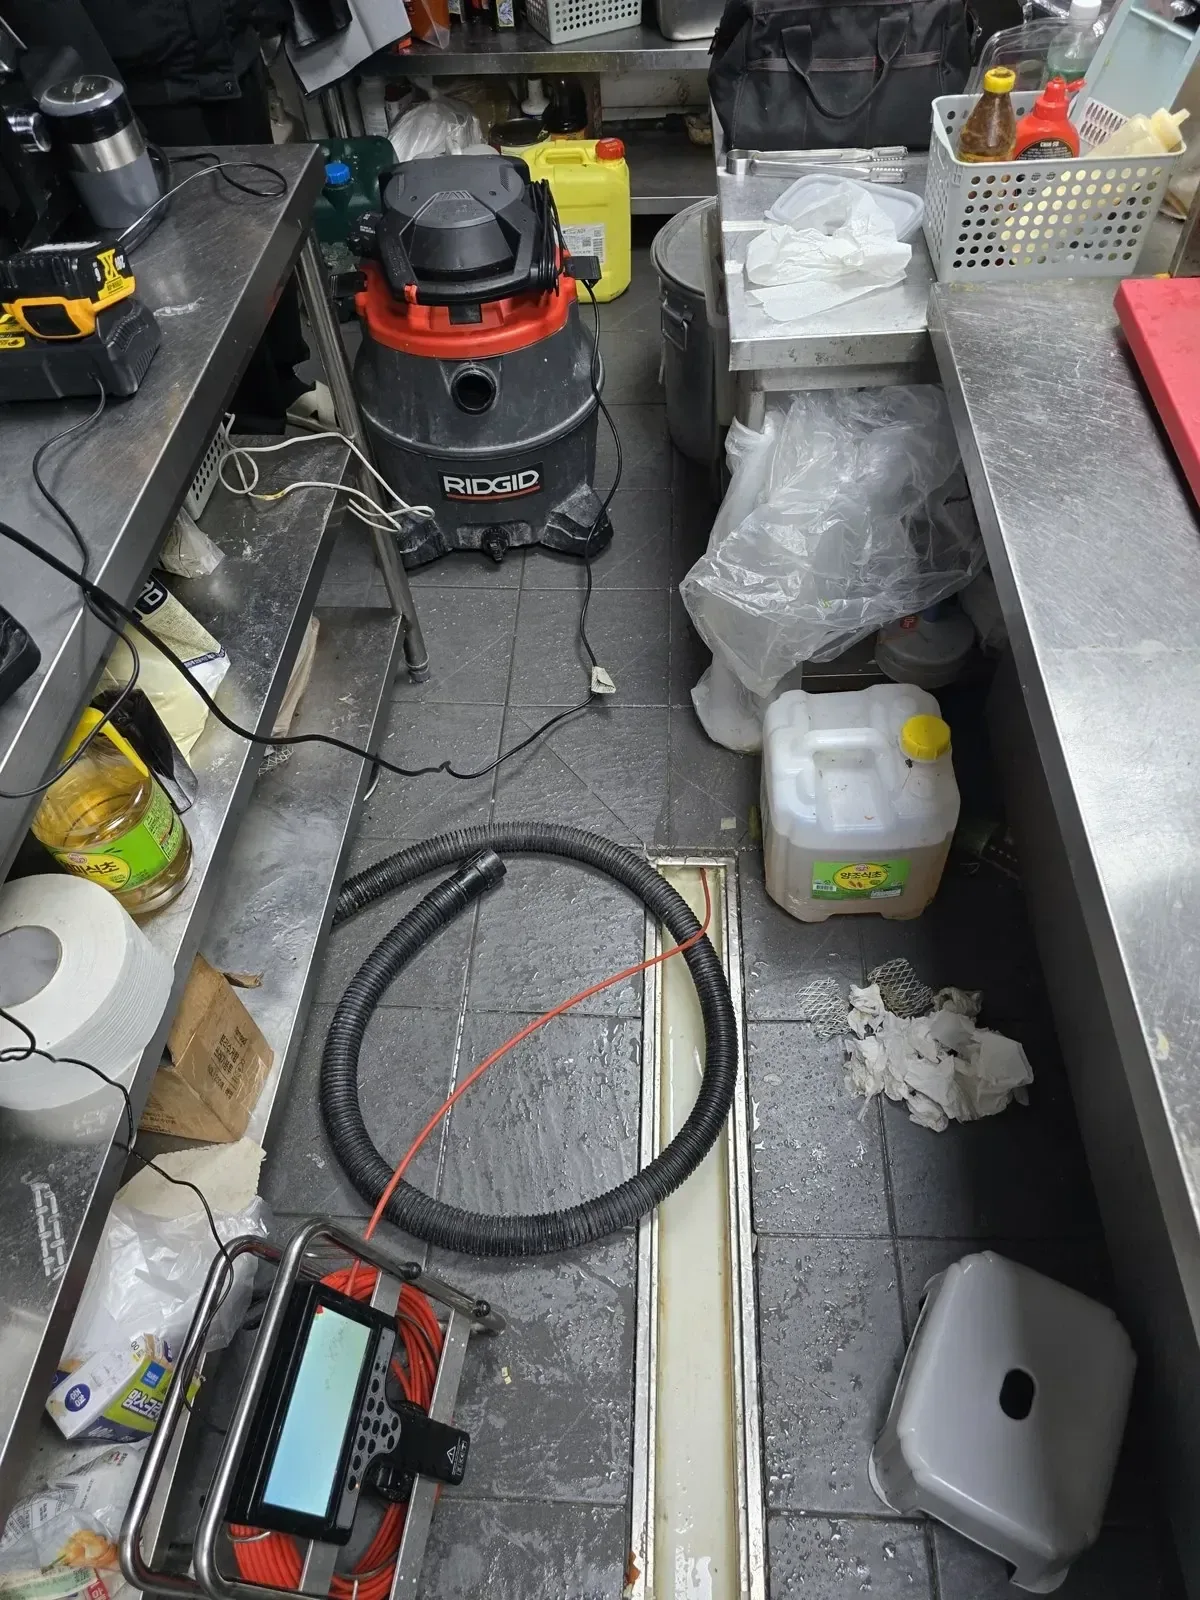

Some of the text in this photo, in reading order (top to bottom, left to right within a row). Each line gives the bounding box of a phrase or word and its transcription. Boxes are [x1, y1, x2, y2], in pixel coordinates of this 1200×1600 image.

[443, 470, 540, 495] RIDGID
[840, 871, 882, 880] 양조식초
[69, 1387, 87, 1408] 중형
[121, 1387, 165, 1421] 맘스크린
